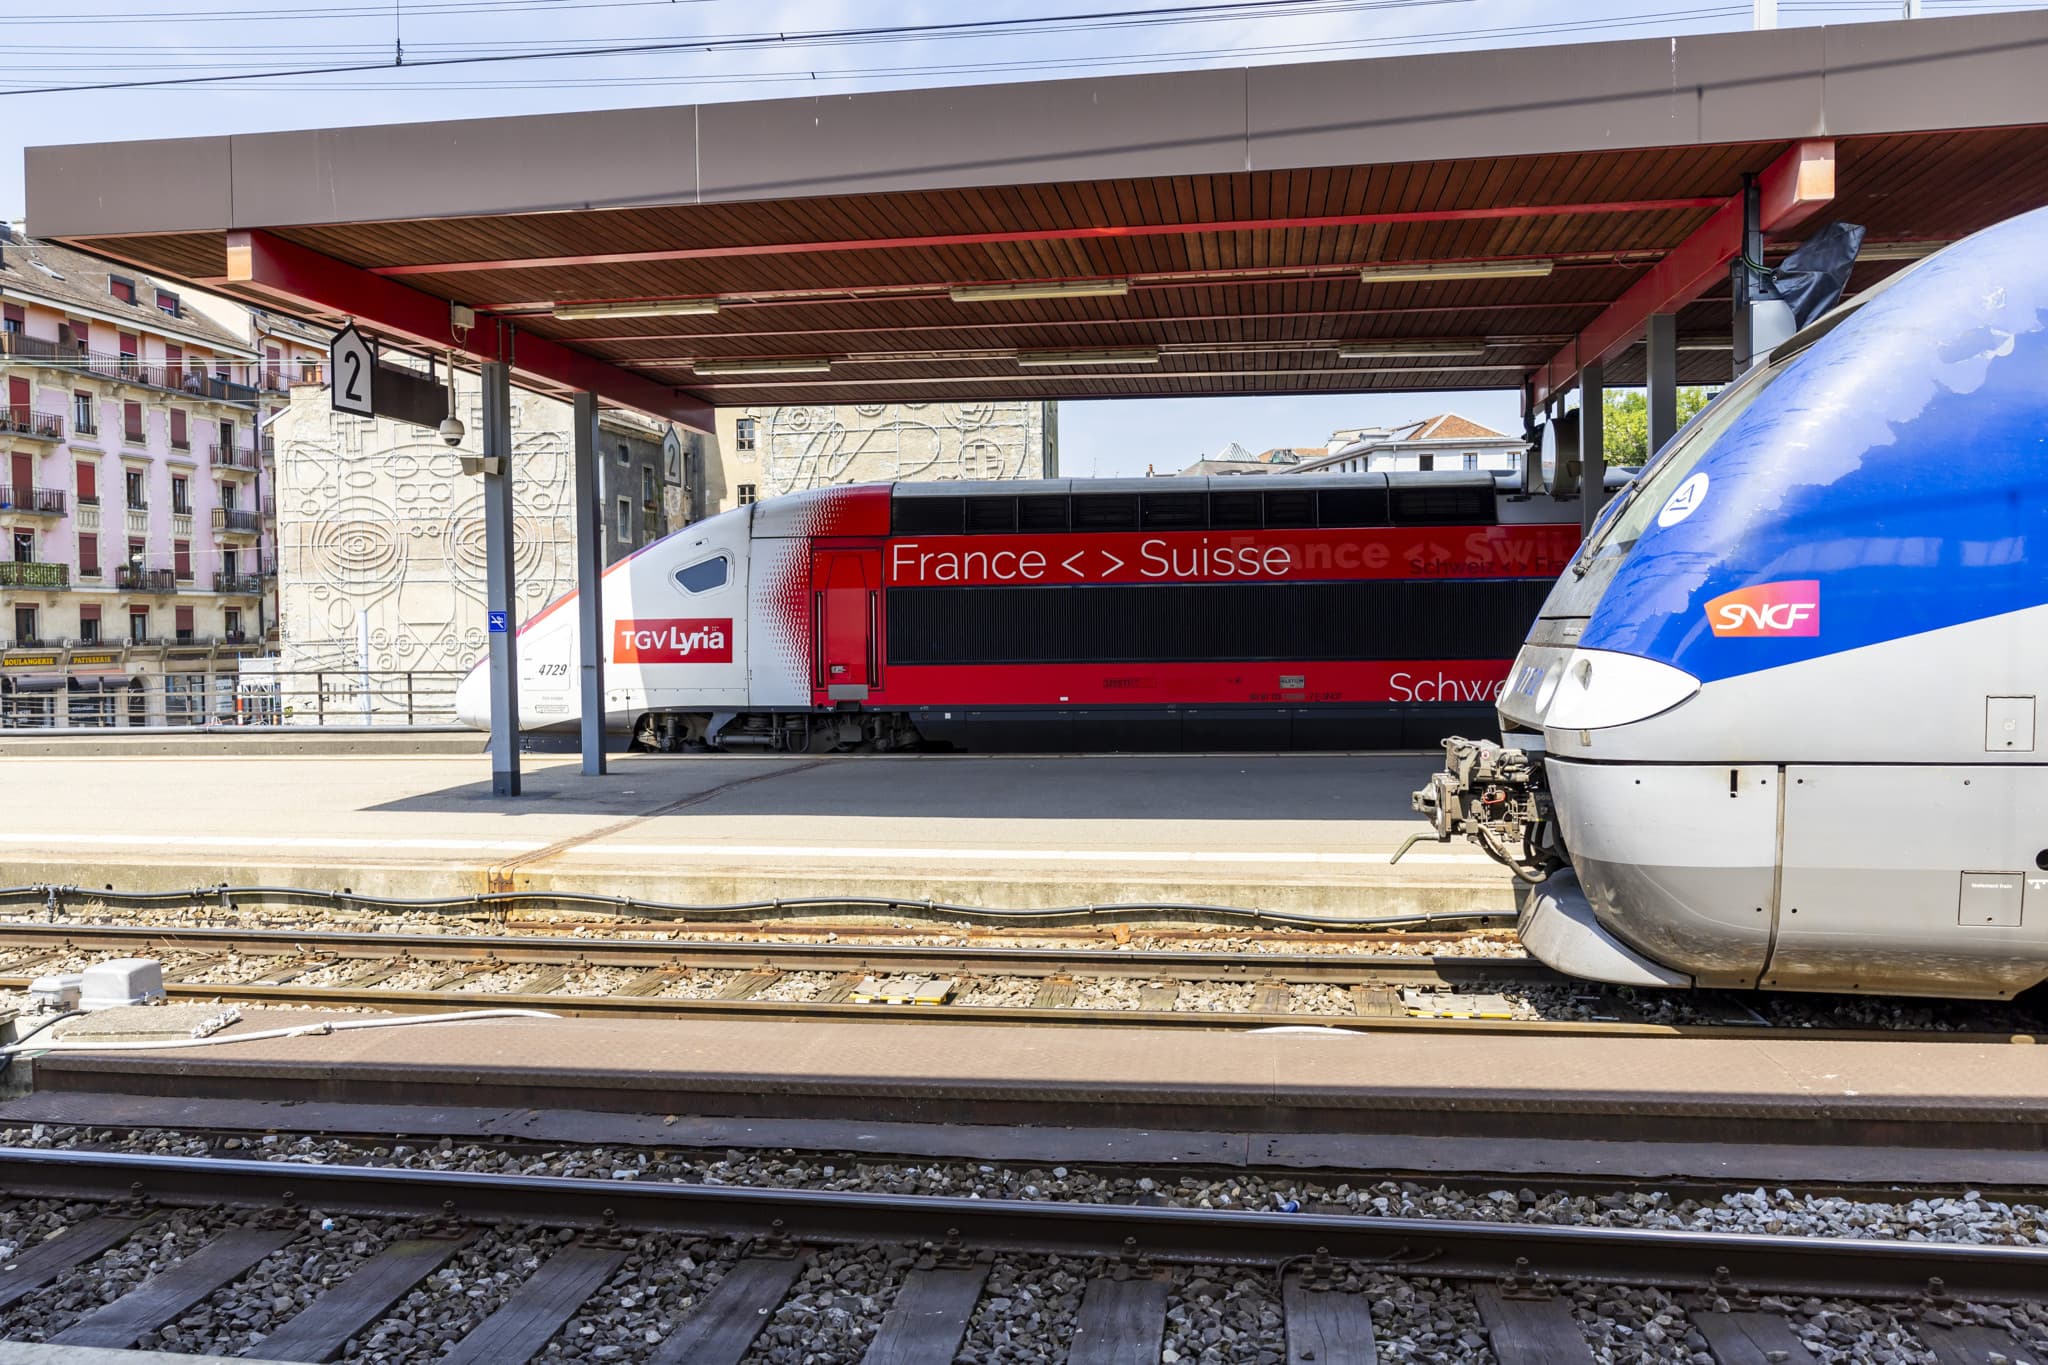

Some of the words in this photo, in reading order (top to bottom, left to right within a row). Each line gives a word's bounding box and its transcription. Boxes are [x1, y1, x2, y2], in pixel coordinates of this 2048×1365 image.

[344, 350, 362, 402] 2
[668, 444, 676, 477] 2
[892, 543, 1047, 581] France
[1139, 538, 1291, 578] Suisse
[1715, 603, 1816, 630] SNCF
[621, 630, 667, 650] TGV
[670, 625, 725, 656] Lyria
[4, 656, 55, 666] BOULANGERIE
[538, 663, 568, 676] 4729
